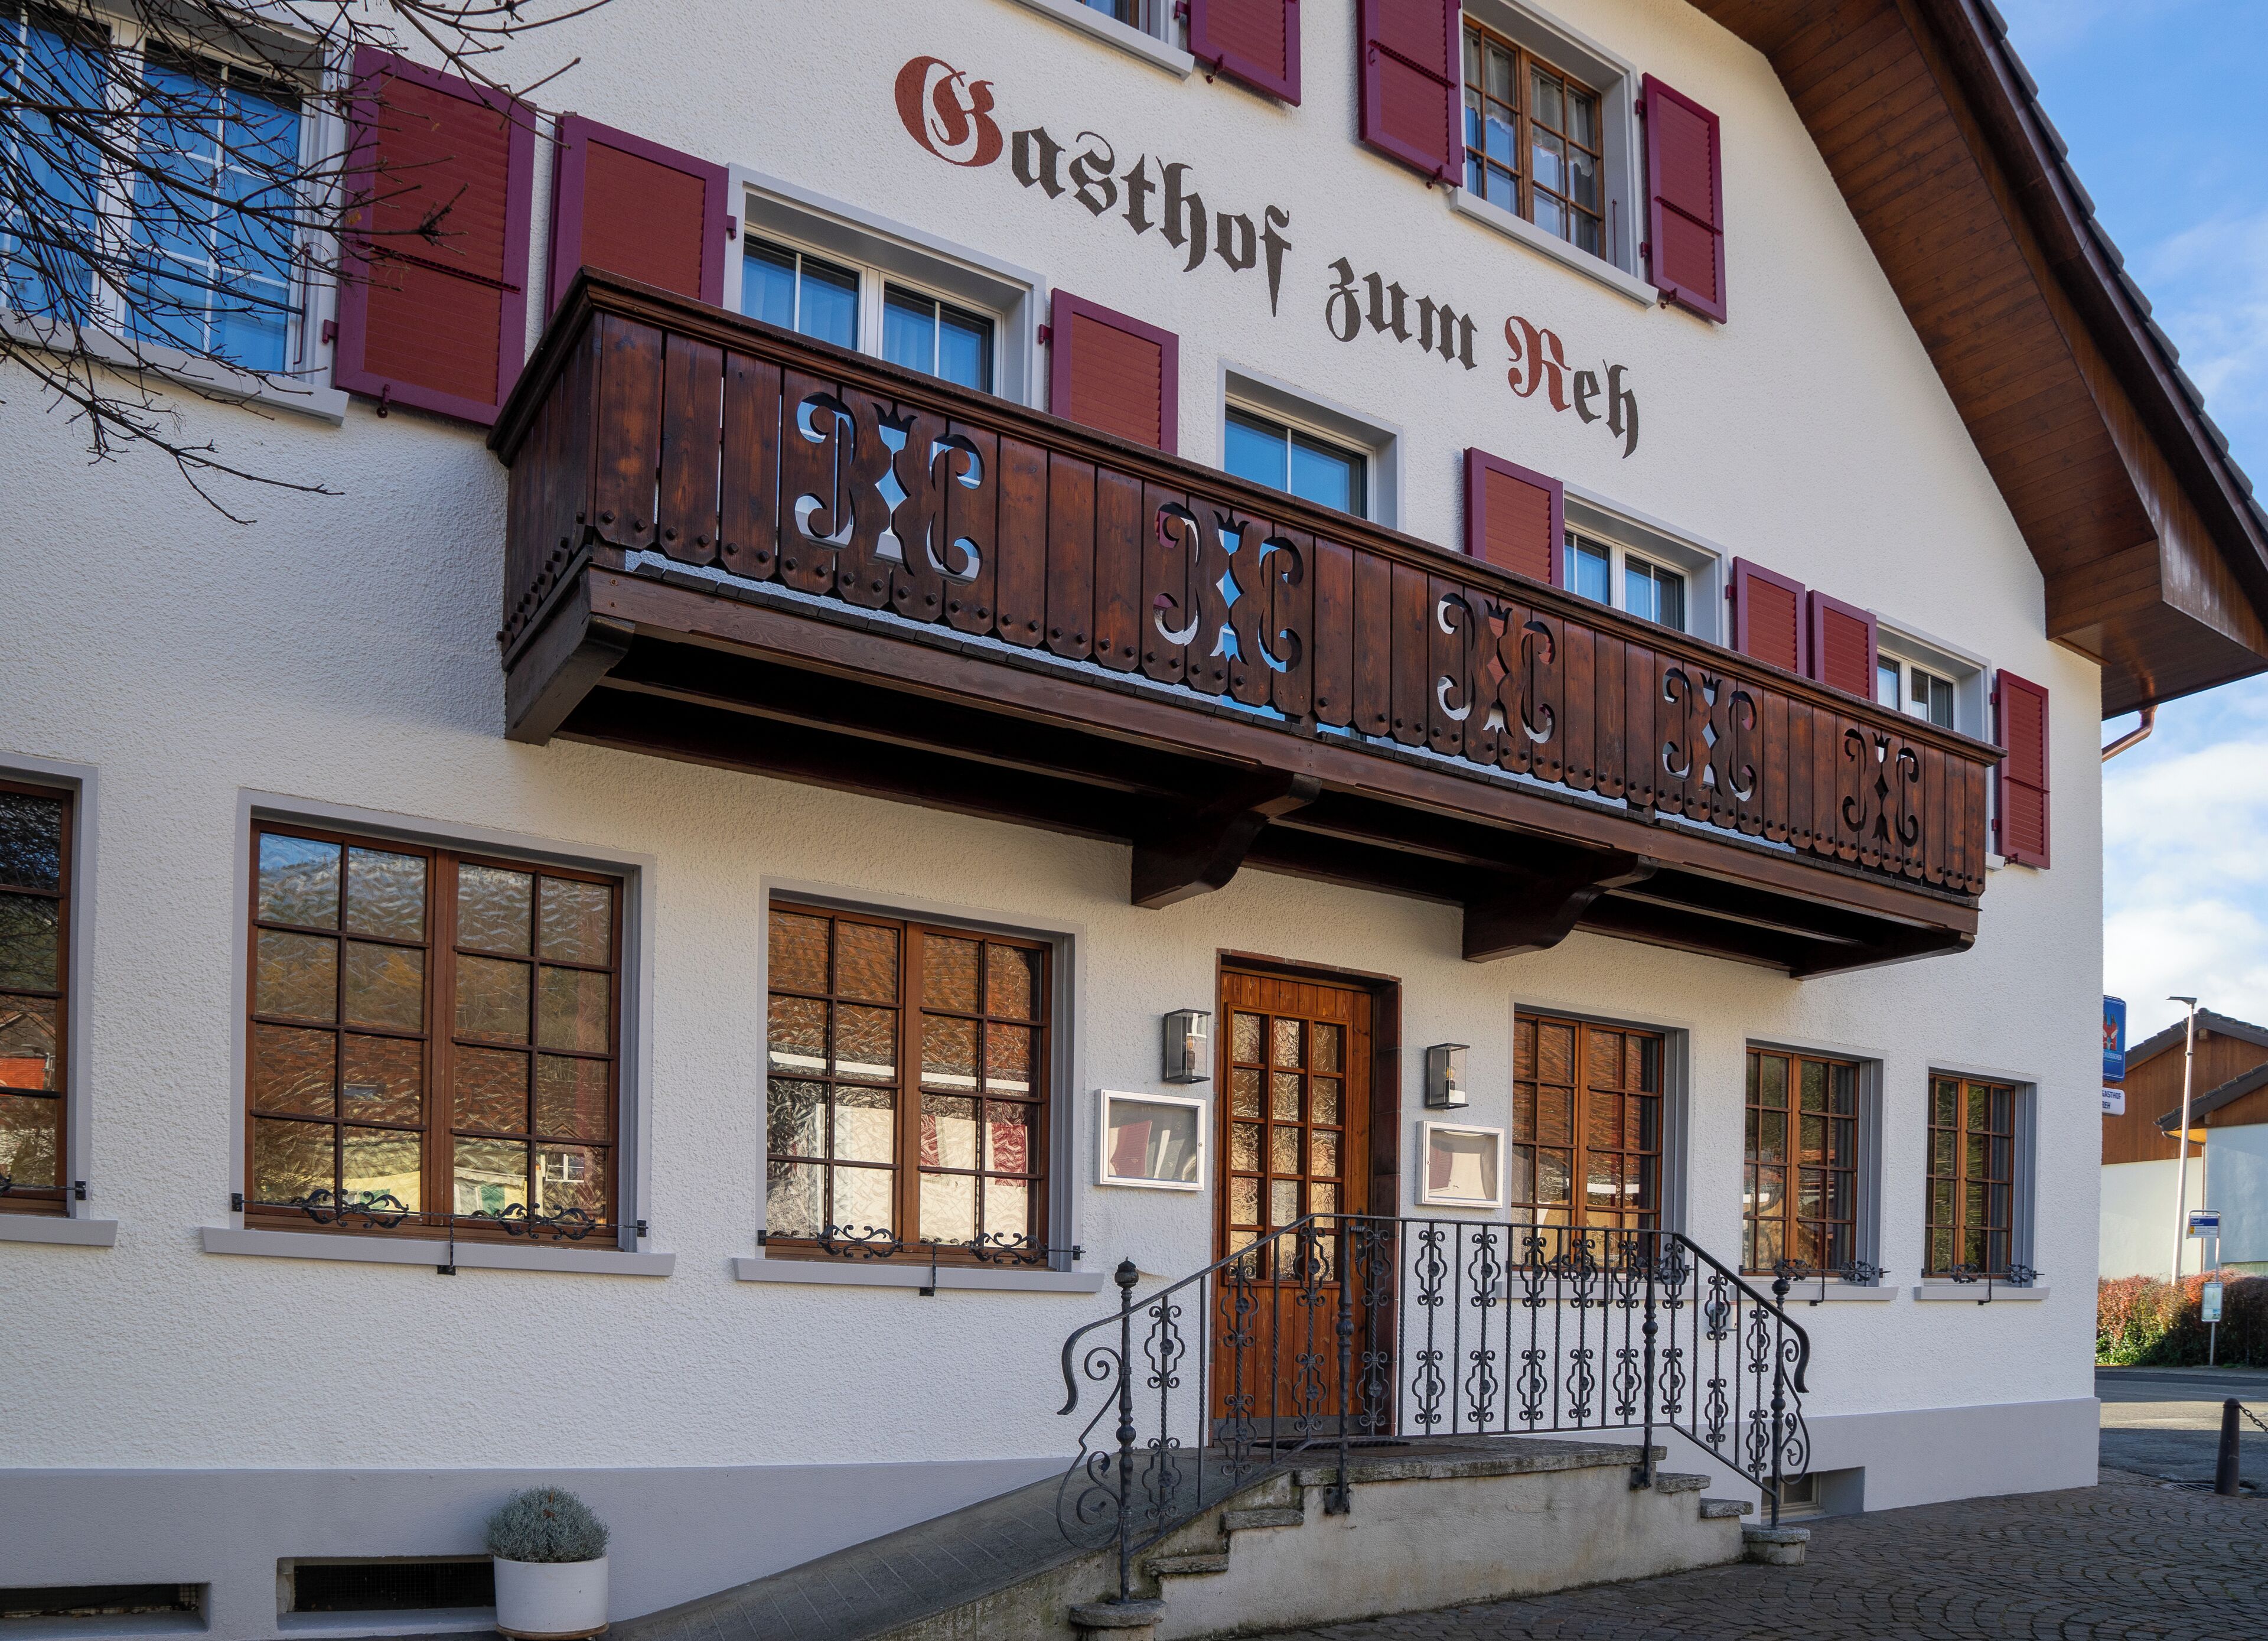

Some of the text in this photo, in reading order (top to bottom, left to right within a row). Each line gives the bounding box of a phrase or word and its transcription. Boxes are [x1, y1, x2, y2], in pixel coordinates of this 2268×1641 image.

[894, 56, 1639, 459] Gasthof zum Reh
